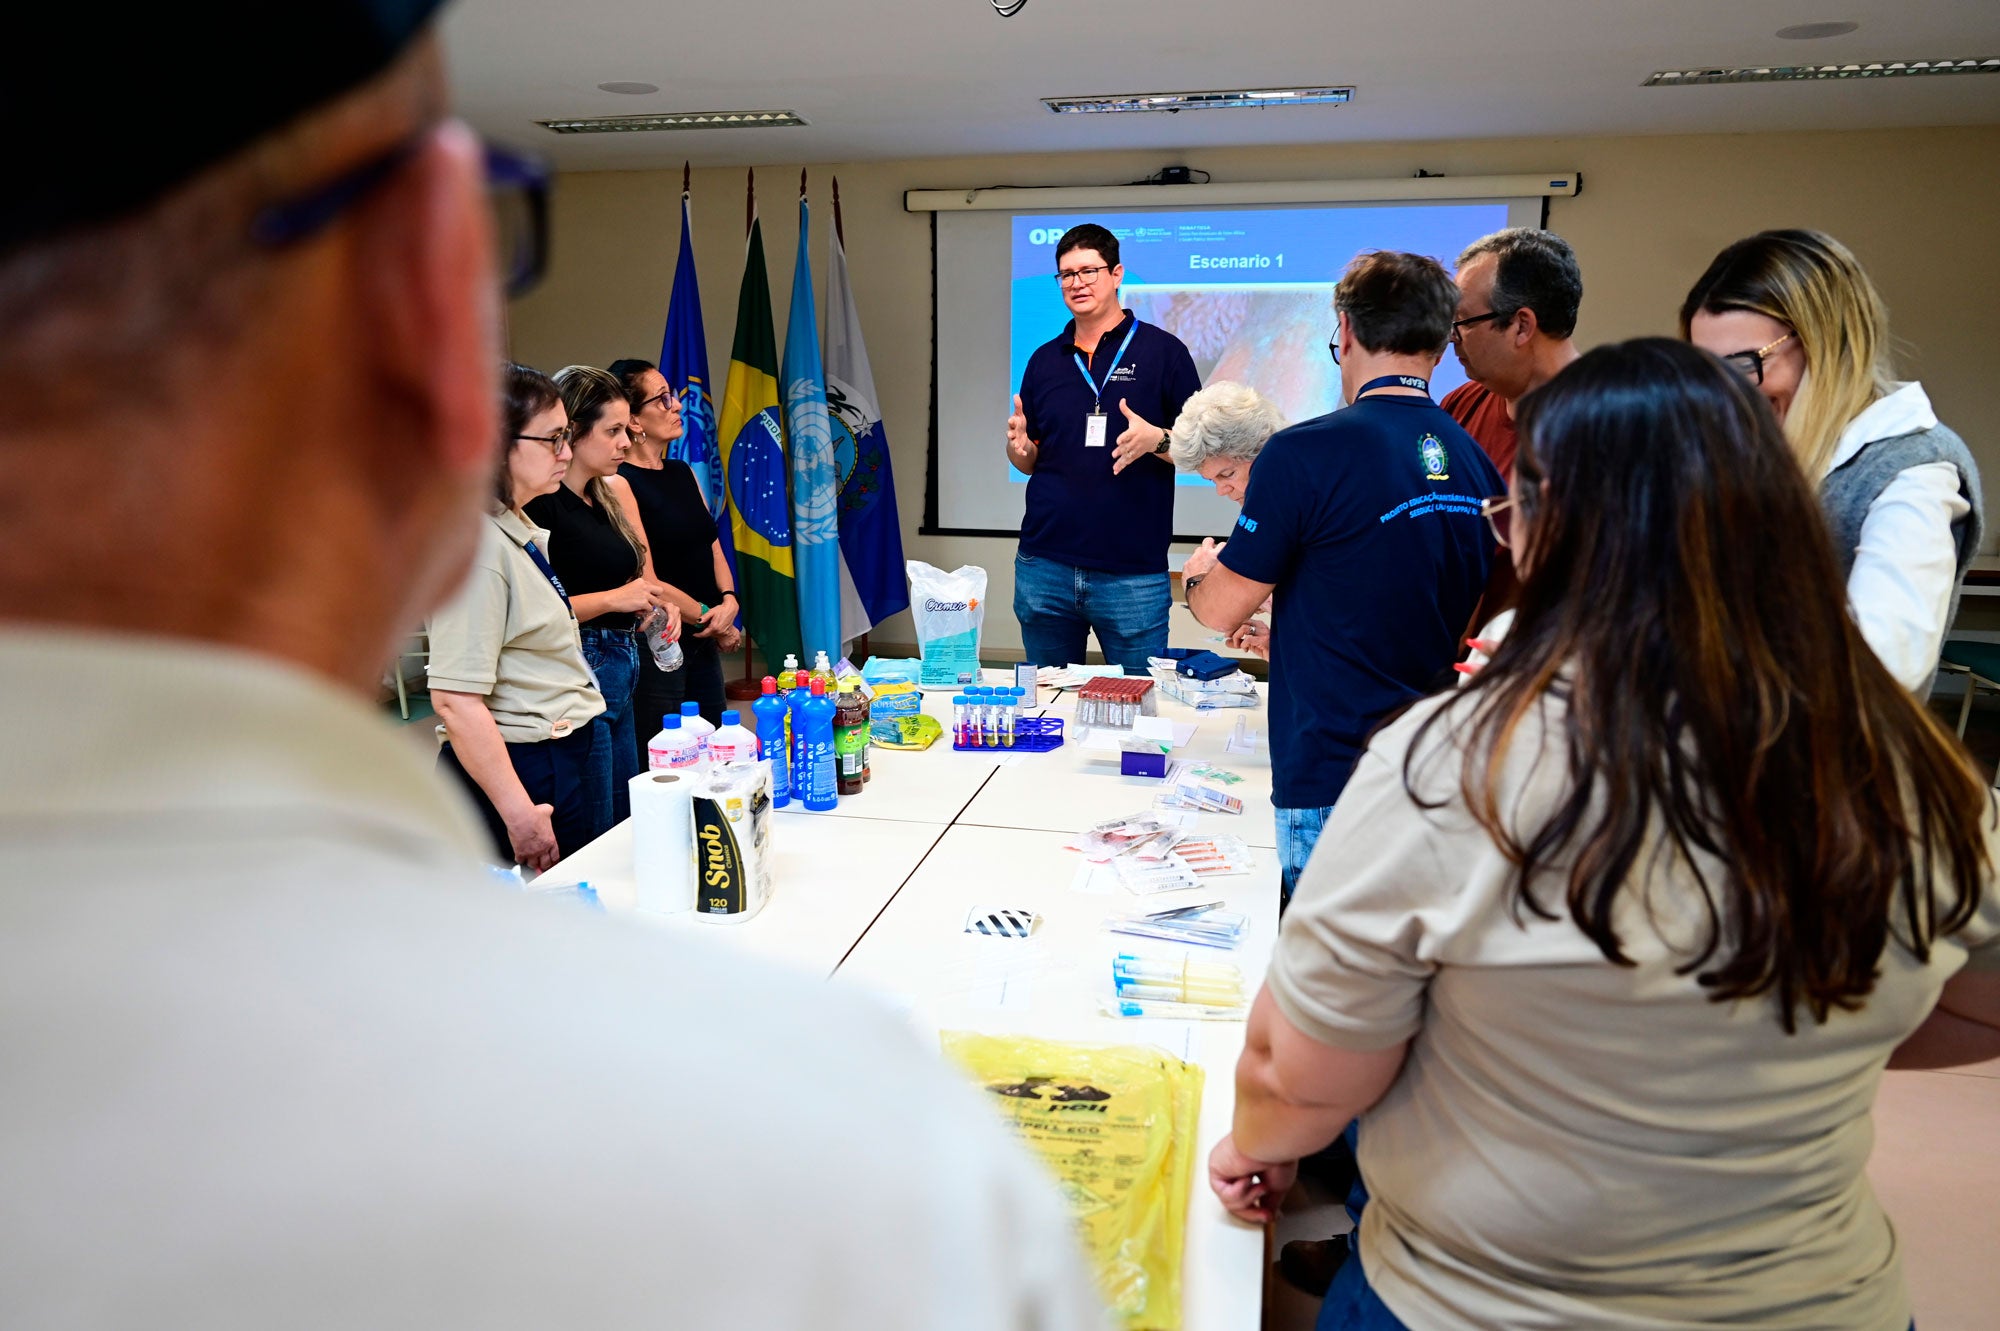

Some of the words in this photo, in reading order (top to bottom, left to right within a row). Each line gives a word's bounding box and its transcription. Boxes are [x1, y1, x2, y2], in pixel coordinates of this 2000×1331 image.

[1190, 254, 1271, 269] Escenario
[1276, 253, 1284, 268] 1
[1380, 502, 1409, 523] PROJETO
[699, 824, 730, 889] Snob
[709, 898, 728, 908] 120
